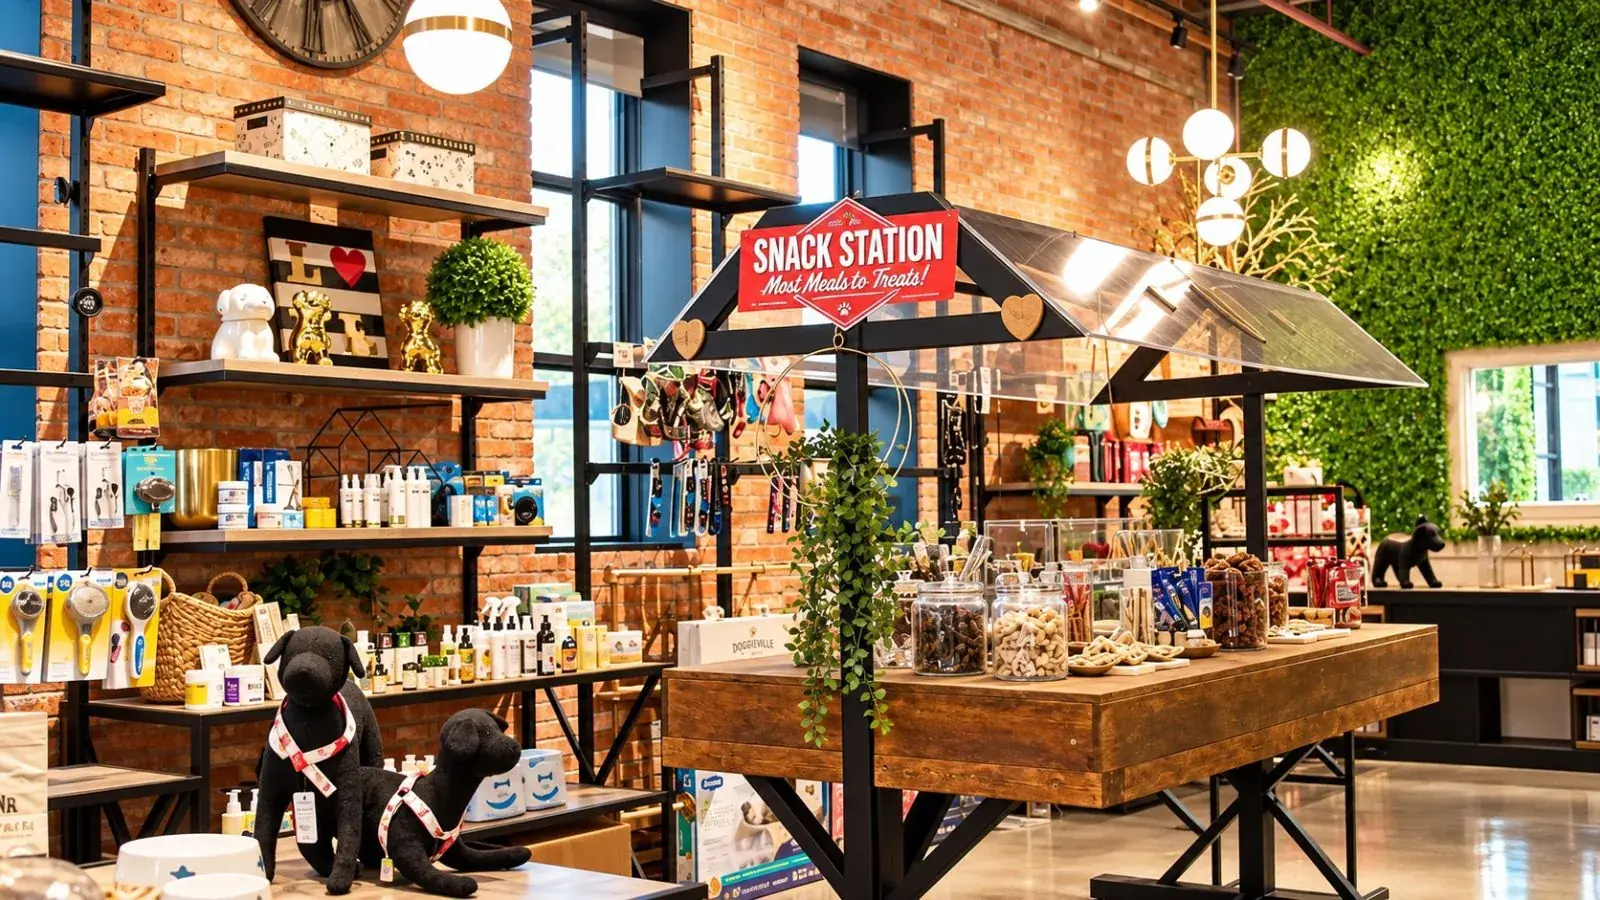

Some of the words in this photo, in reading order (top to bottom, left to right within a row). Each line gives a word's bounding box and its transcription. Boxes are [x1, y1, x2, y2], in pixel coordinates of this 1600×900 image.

[753, 233, 833, 274] SNACK
[839, 223, 943, 267] STATION
[761, 273, 802, 296] Most
[801, 270, 851, 294] Meals
[849, 270, 869, 290] to
[872, 264, 930, 289] Treats!
